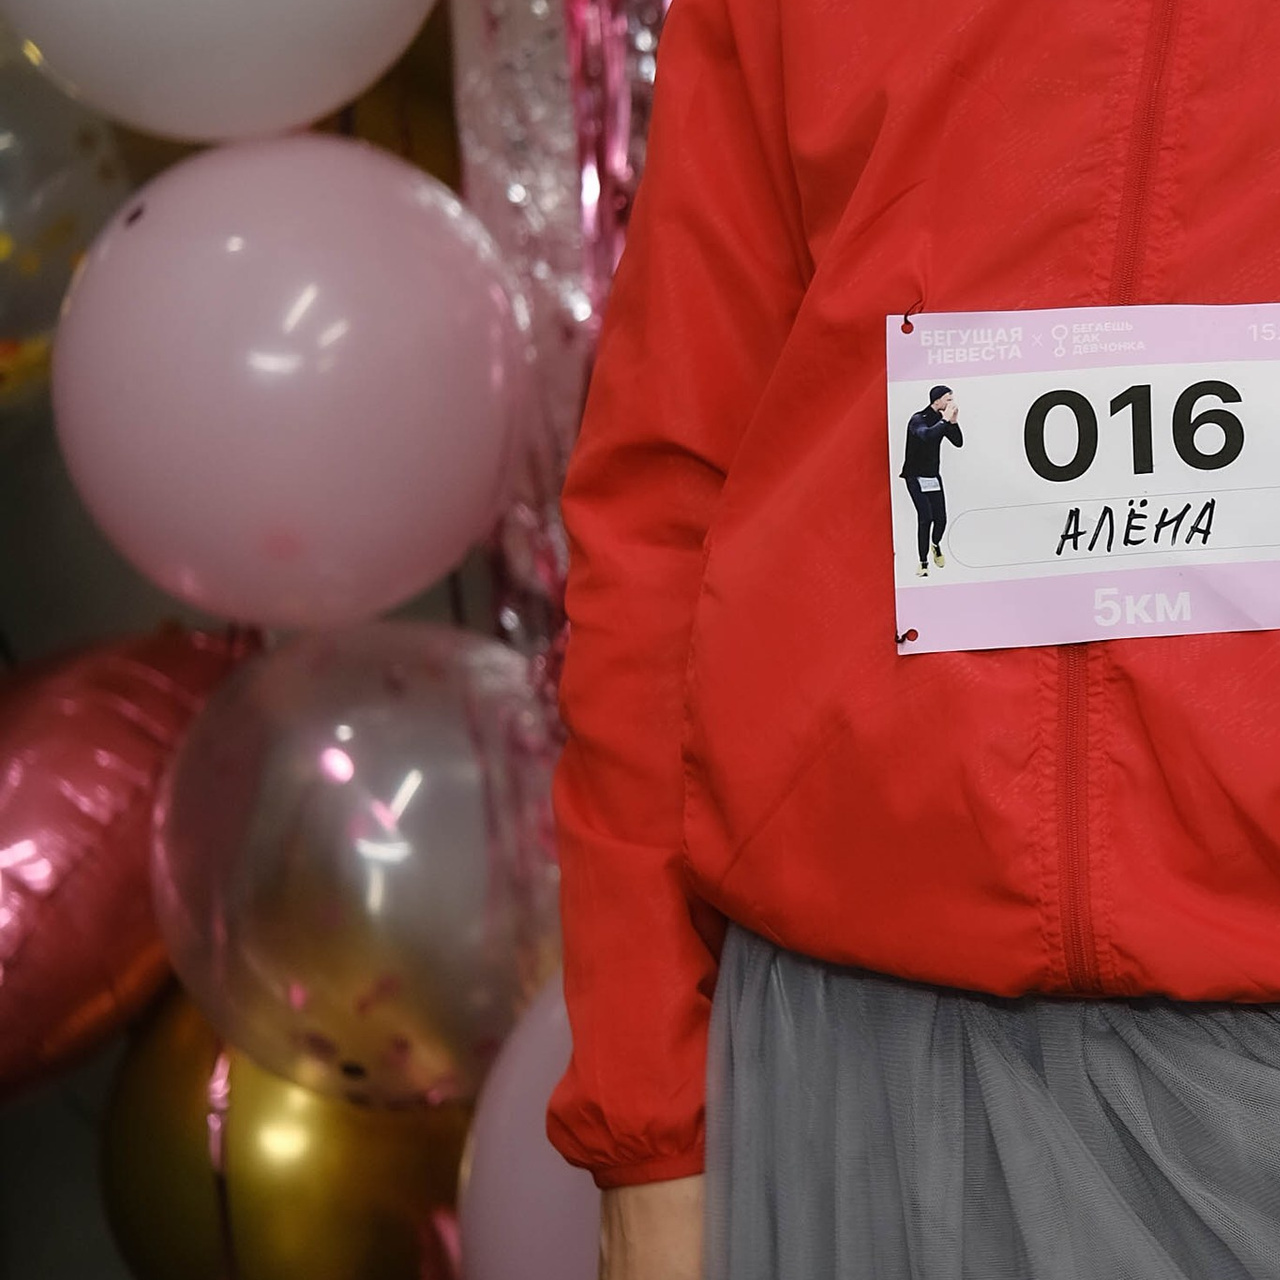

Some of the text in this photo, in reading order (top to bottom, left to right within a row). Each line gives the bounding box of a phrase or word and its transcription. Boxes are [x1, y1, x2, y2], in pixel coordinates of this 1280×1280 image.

[920, 326, 1022, 347] БЕГУЩАЯ
[1072, 332, 1100, 344] КАК
[927, 343, 1023, 365] НЕВЕСТА
[1072, 340, 1147, 355] ДЕВЧОНКА
[1023, 379, 1245, 483] 016
[1056, 497, 1216, 556] АЛЁНА
